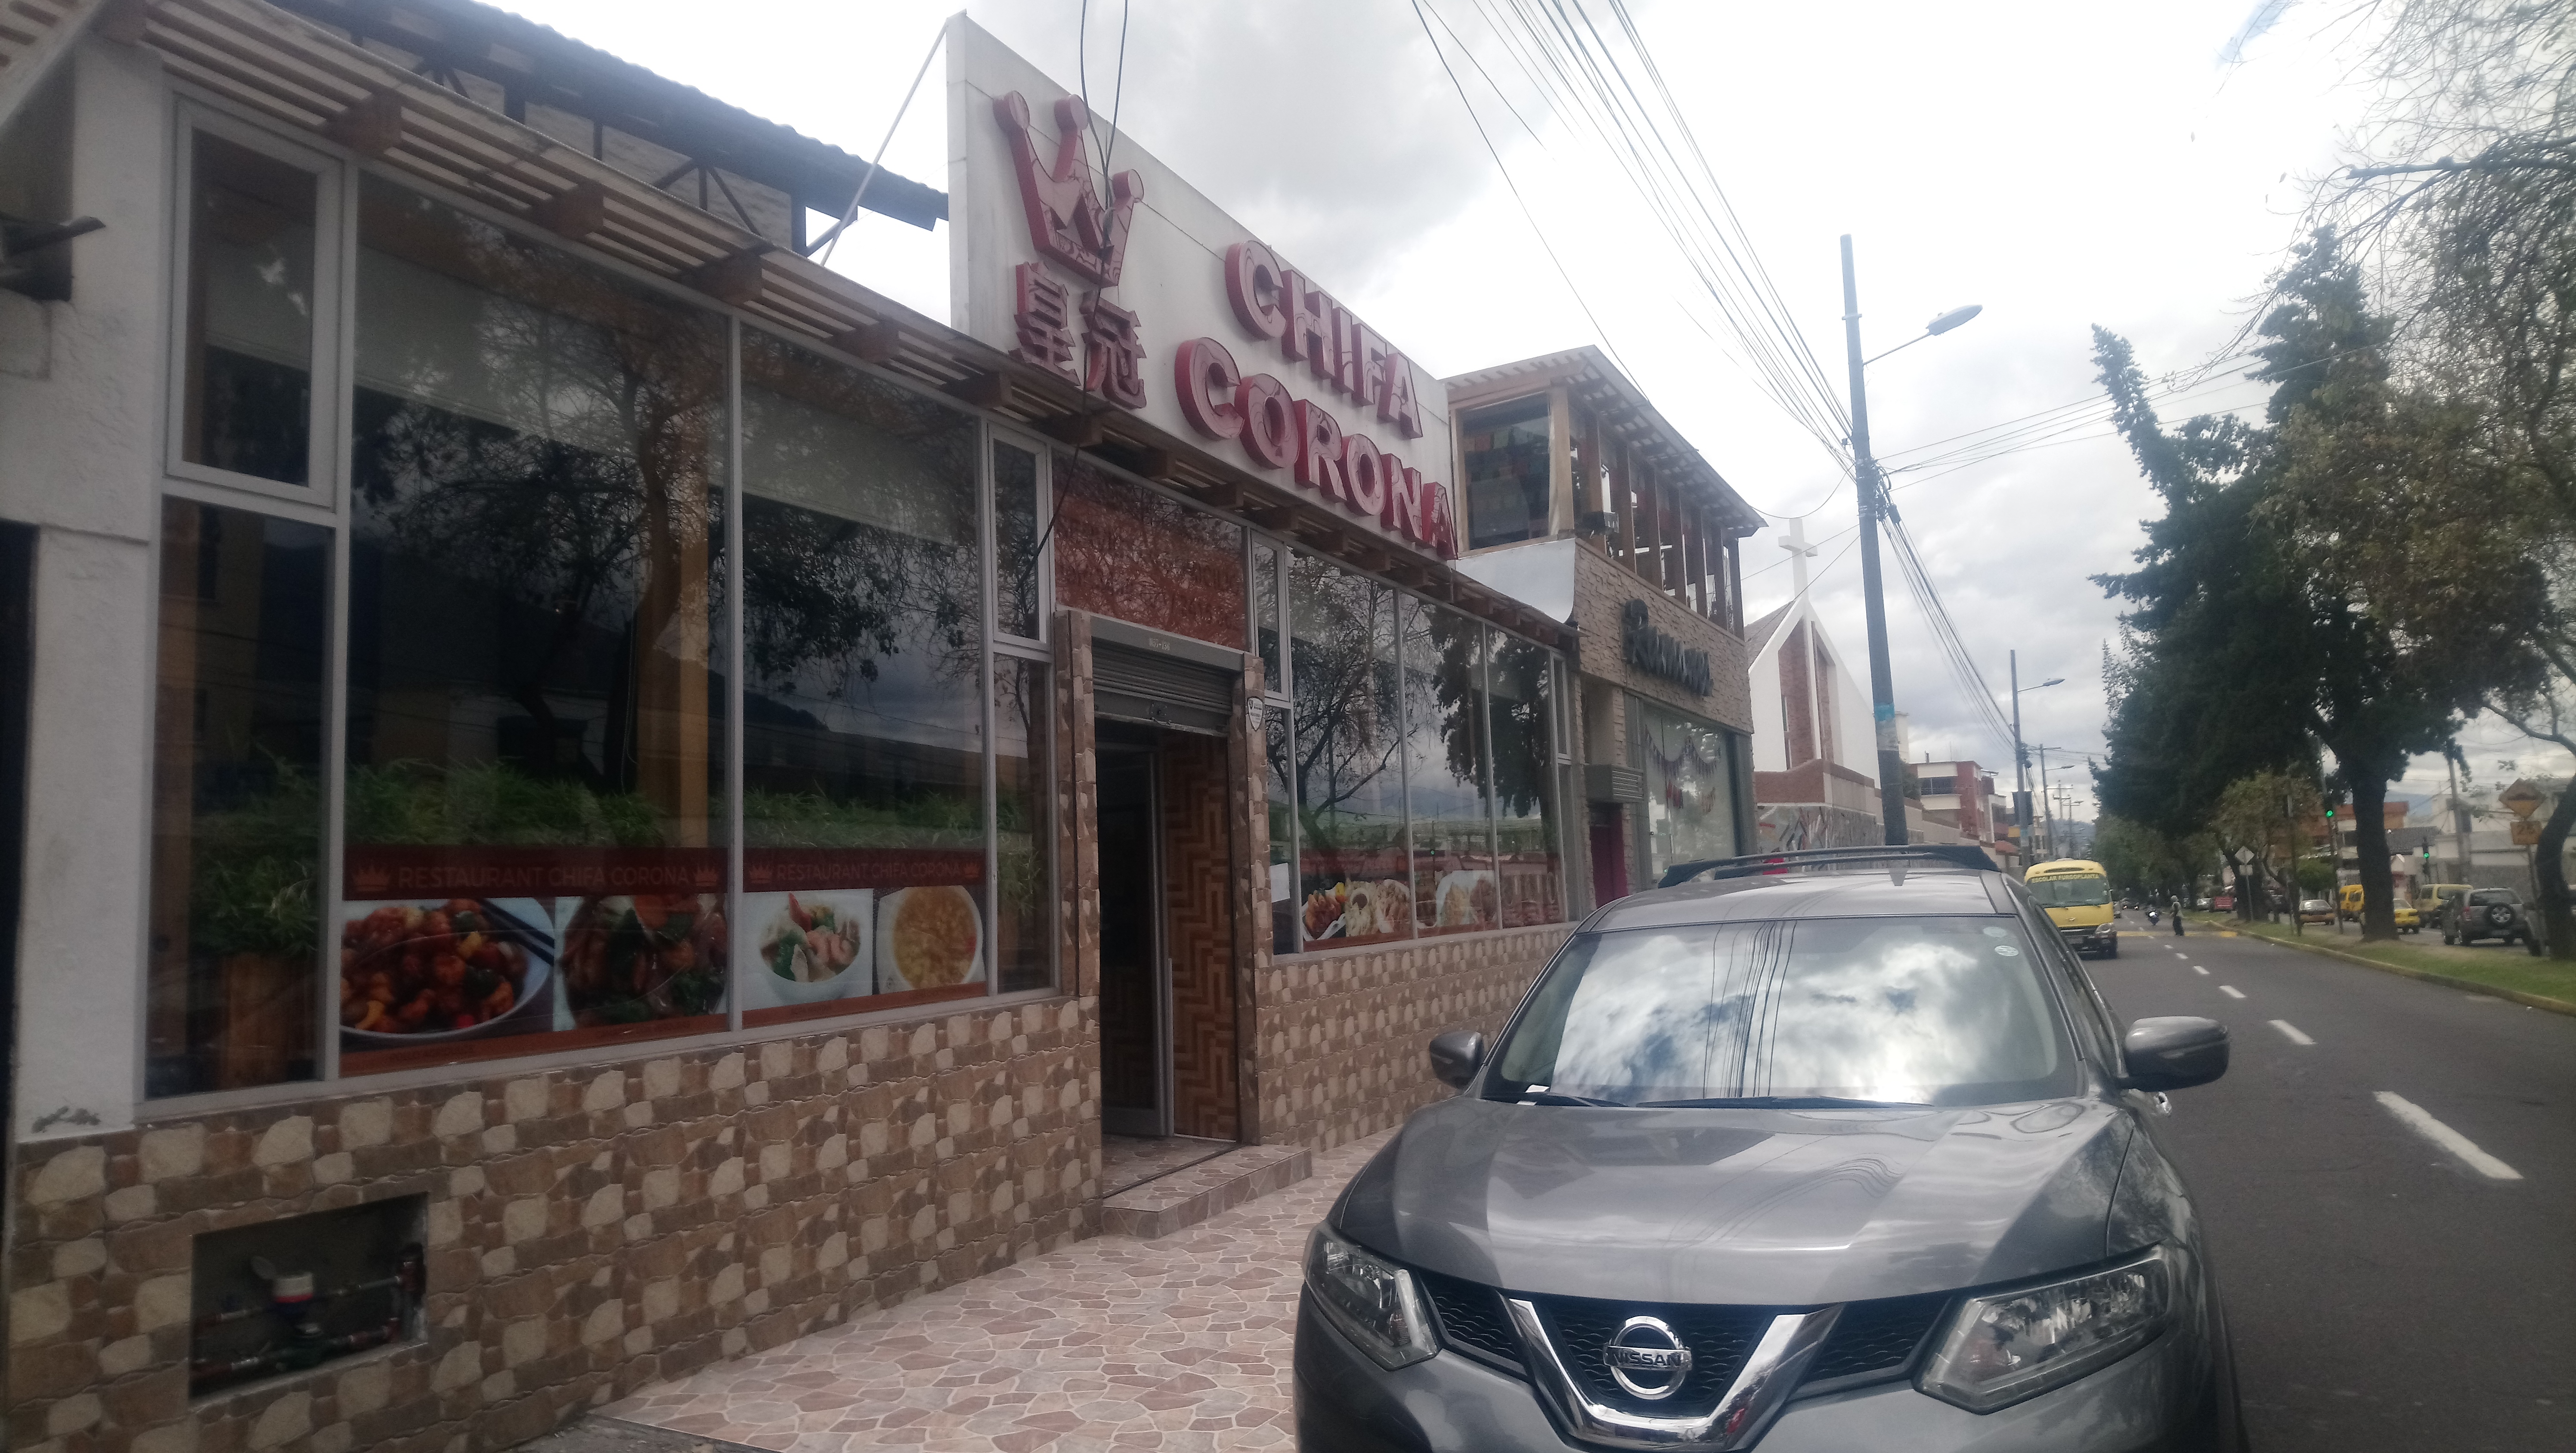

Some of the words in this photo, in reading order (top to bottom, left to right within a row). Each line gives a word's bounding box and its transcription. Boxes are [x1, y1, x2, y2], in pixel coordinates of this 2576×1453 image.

[1008, 261, 1147, 409] 皇冠
[1226, 240, 1423, 439] CHIFA
[1174, 337, 1458, 560] CORONA
[398, 866, 542, 887] RESTAURANT
[548, 866, 605, 887] CHIFA
[611, 866, 689, 886] CORONA
[777, 863, 868, 880] RESTAURANT
[872, 863, 907, 878] CHIFA
[911, 862, 961, 877] CORONA
[1610, 1351, 1680, 1367] NISSAN
